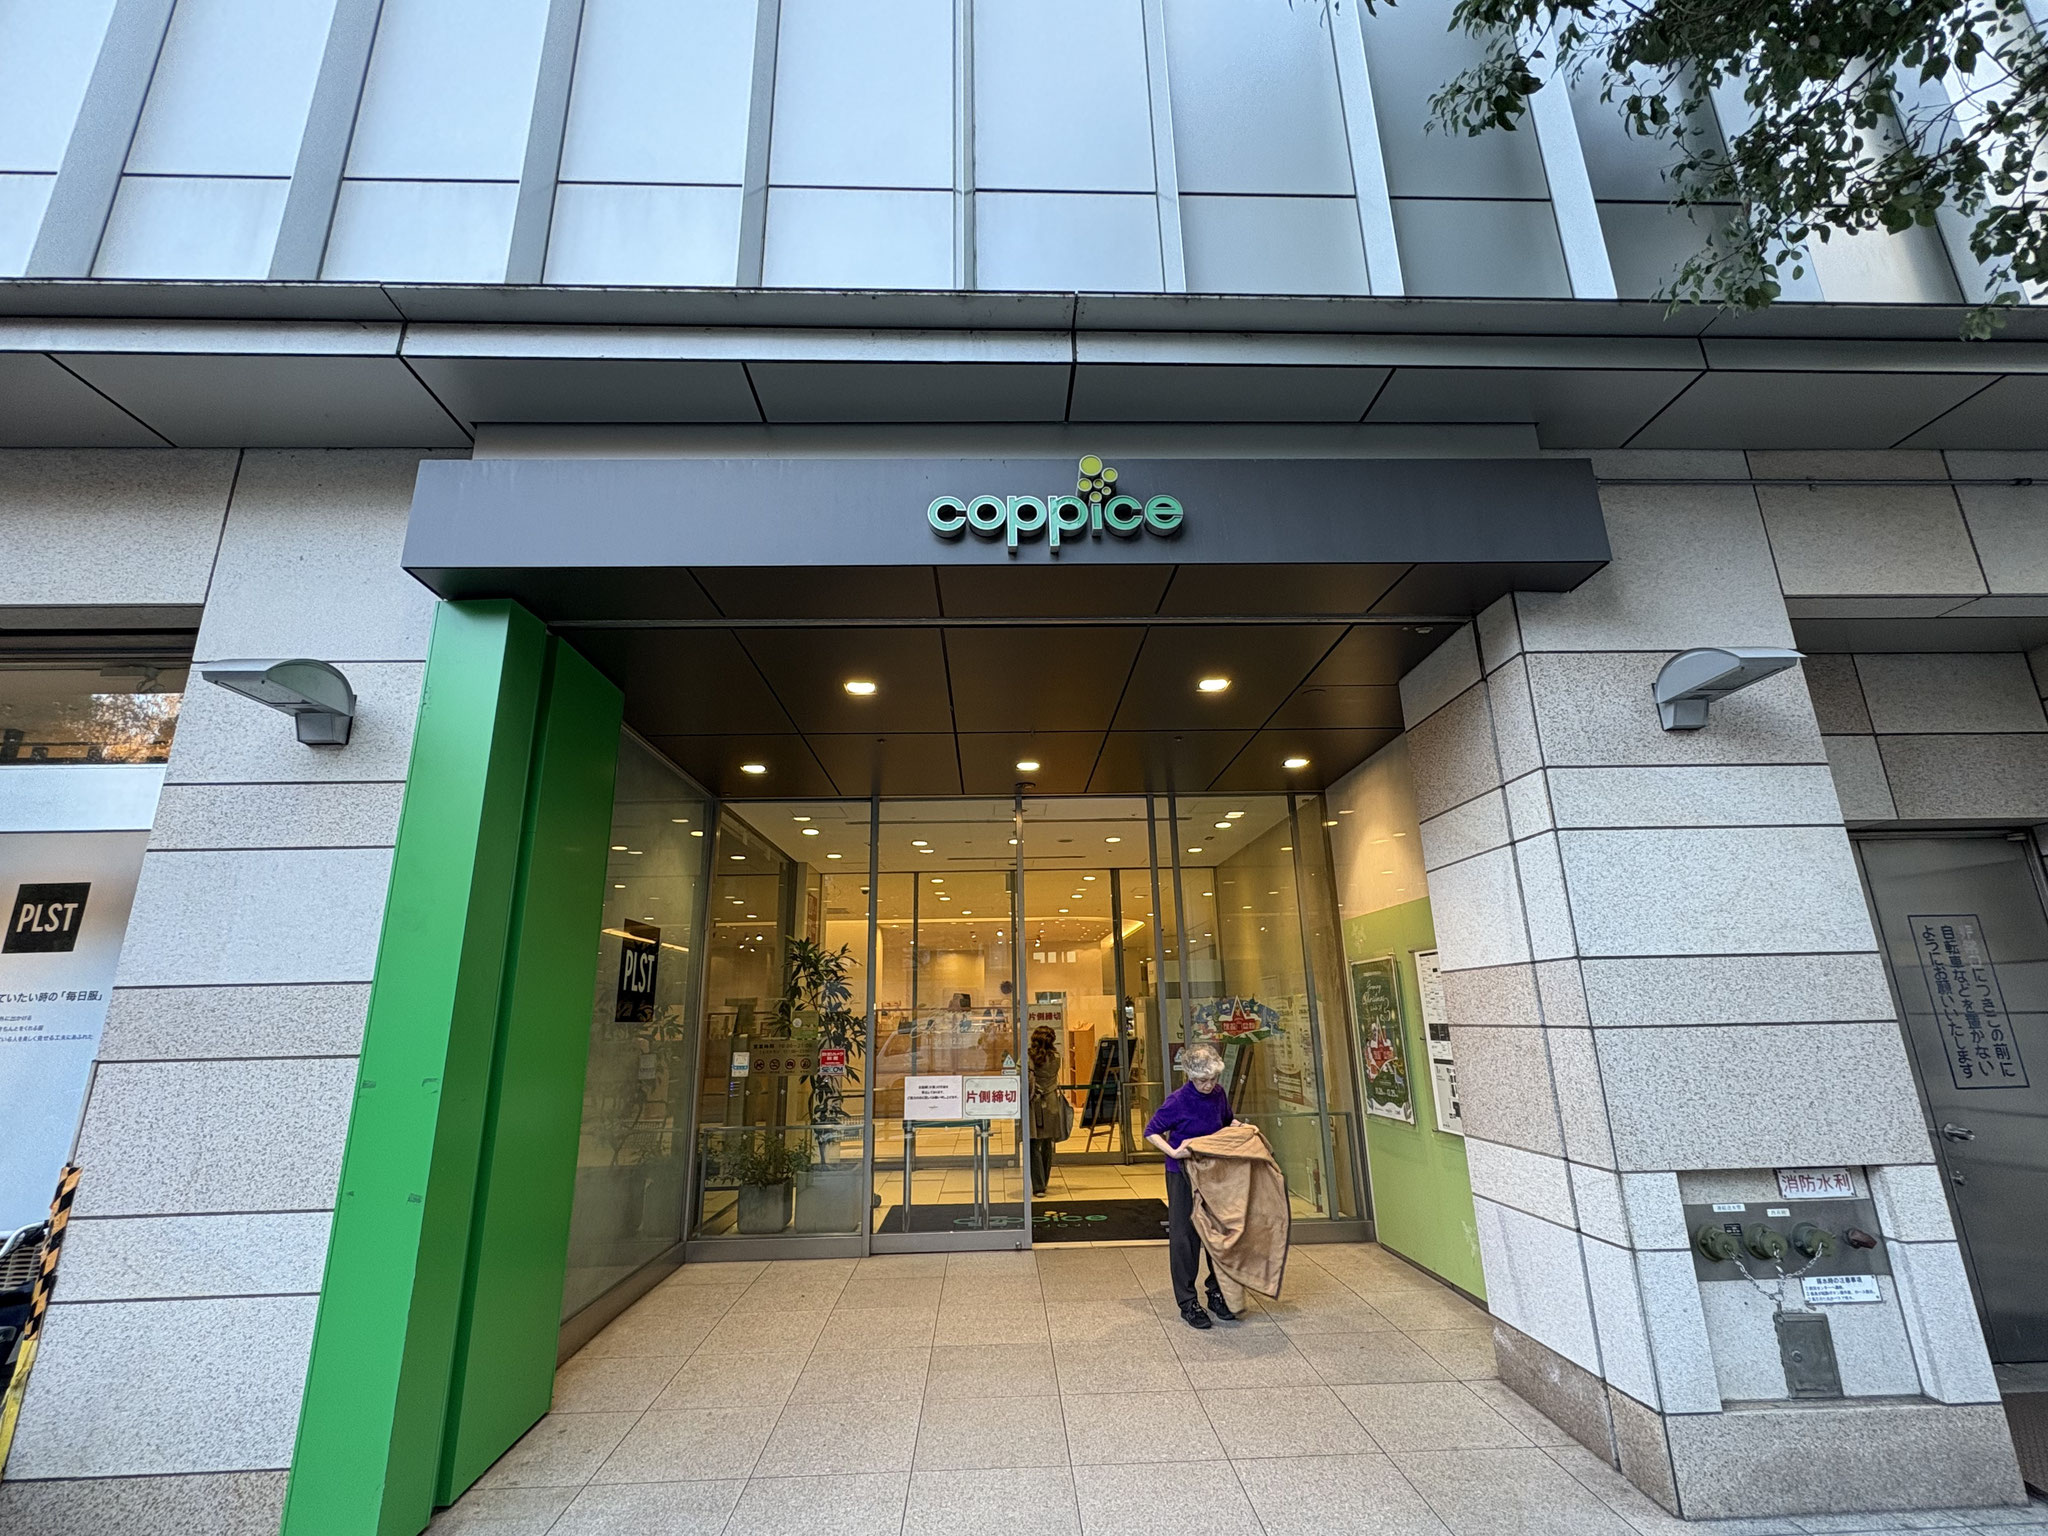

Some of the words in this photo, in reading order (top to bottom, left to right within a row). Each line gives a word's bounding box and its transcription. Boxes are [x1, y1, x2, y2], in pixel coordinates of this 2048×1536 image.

[927, 490, 1183, 552] coppice
[16, 903, 79, 933] PLST
[623, 950, 655, 993] PLST
[966, 1089, 1018, 1104] 片側締切
[1781, 1173, 1851, 1193] 消防水利
